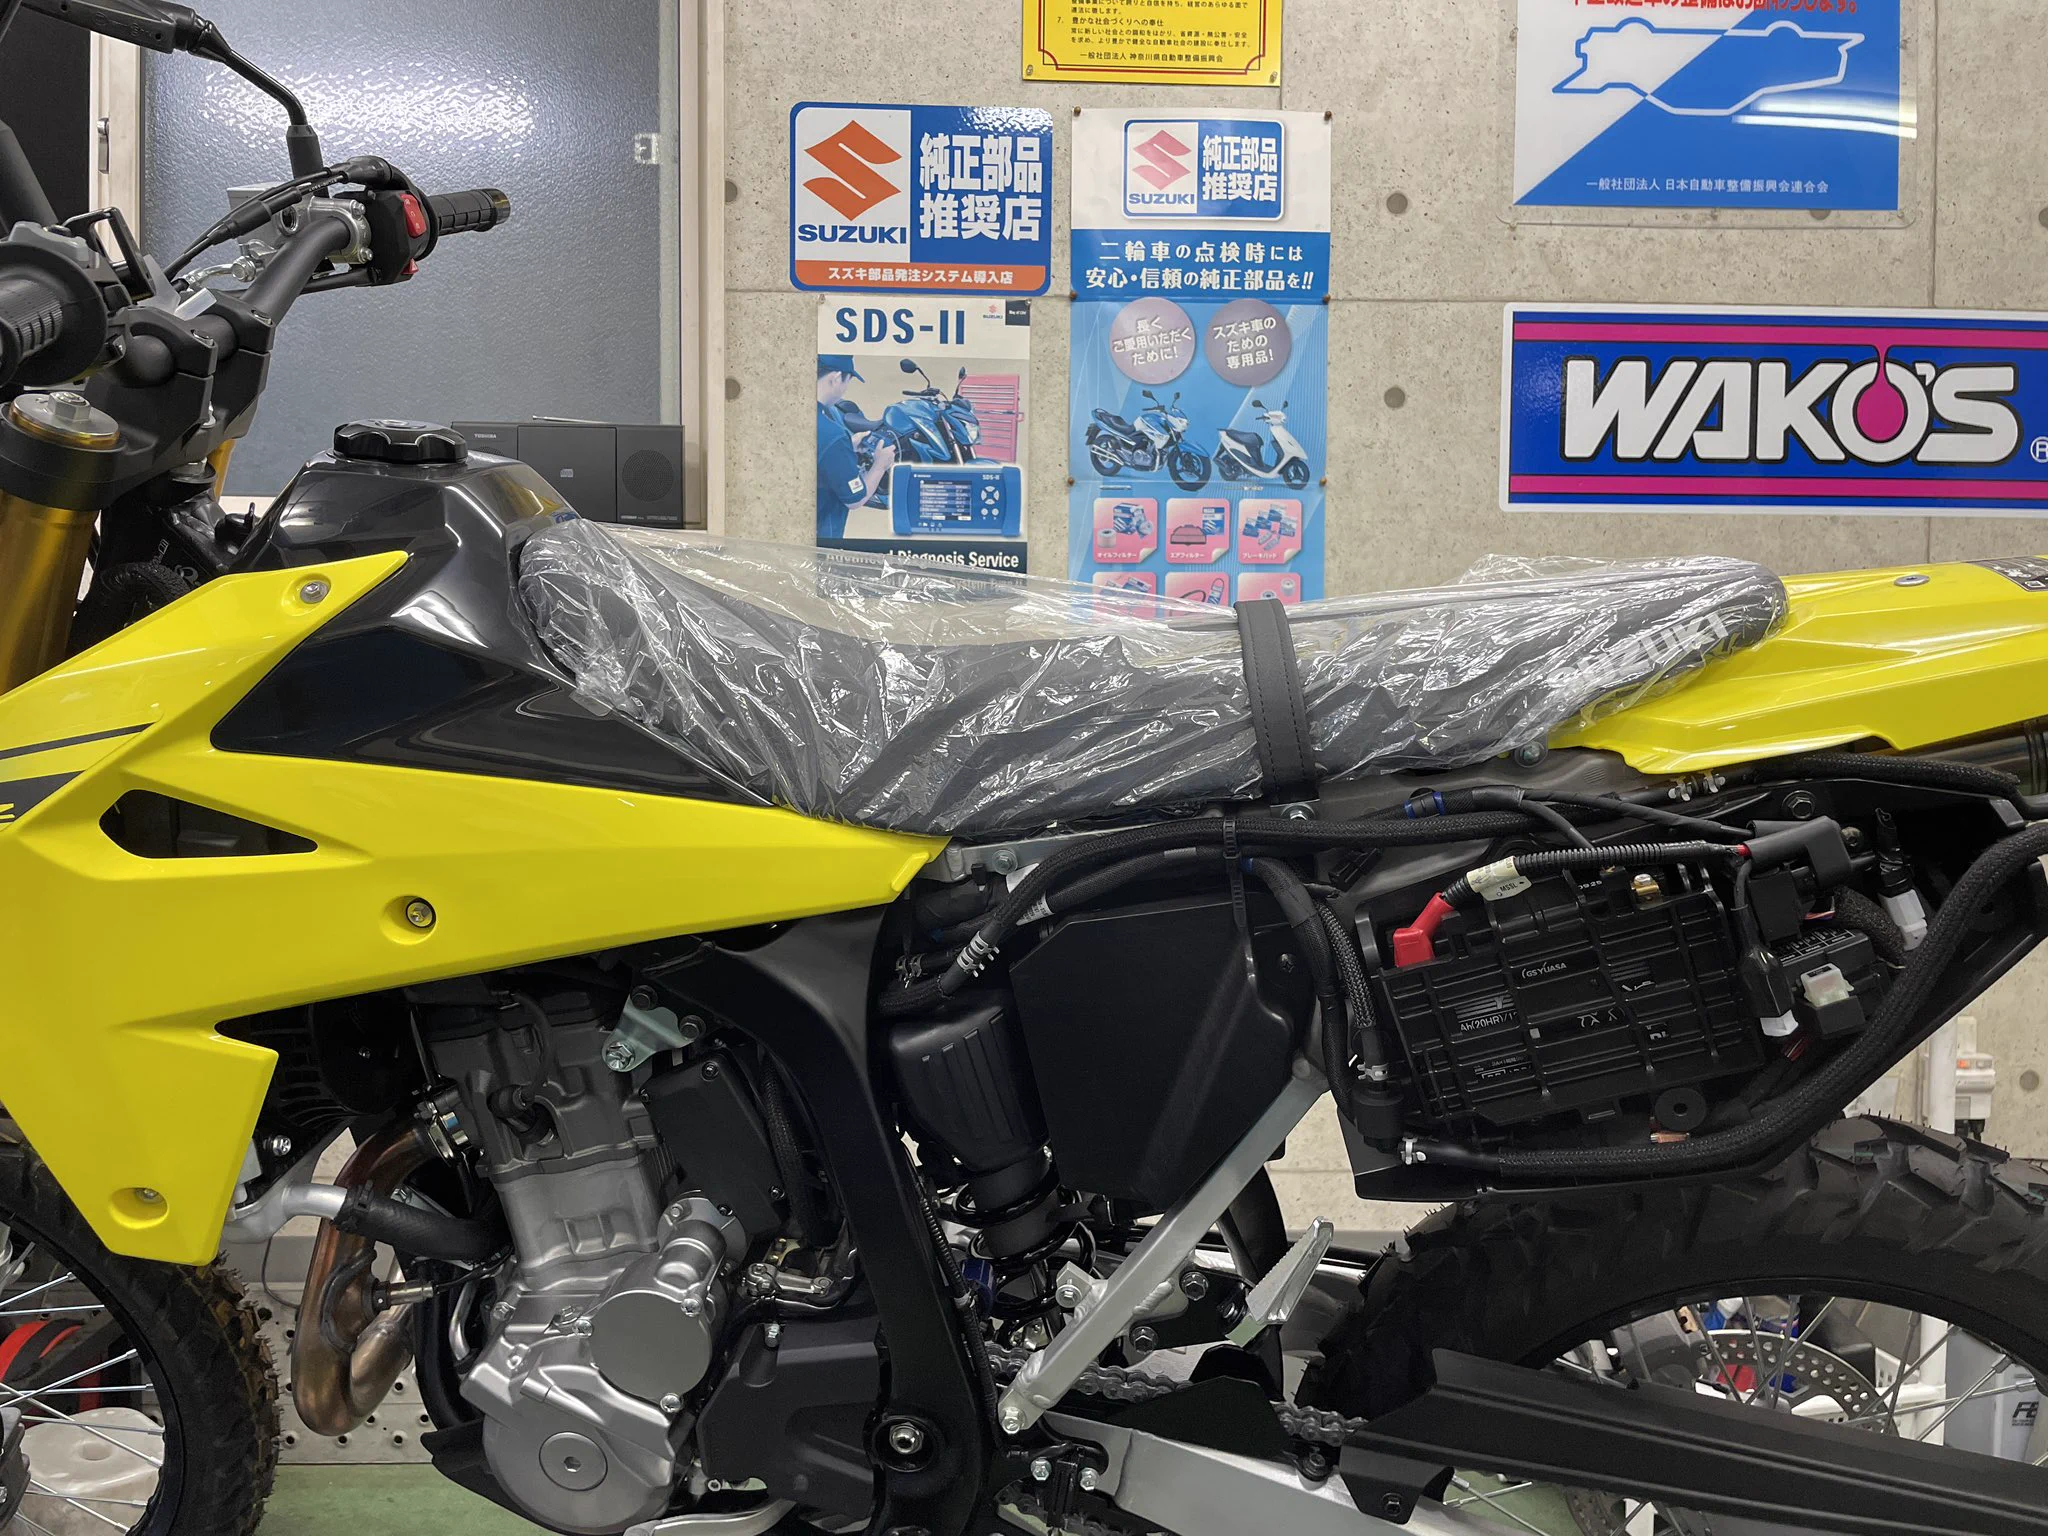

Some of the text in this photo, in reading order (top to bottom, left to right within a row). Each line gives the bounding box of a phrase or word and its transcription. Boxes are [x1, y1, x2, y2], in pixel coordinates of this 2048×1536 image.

[919, 132, 1043, 193] 純正部品
[1202, 135, 1278, 173] 純正部品
[1202, 172, 1278, 202] 推奨店
[1586, 177, 1829, 194] 一般社団法人 日本自動車整備振興会連合会
[1128, 193, 1195, 205] SUZUKI
[919, 192, 1042, 241] 推奨店
[798, 223, 907, 245] SUZUKI
[1099, 240, 1304, 264] 二輪車の点検時には
[828, 266, 1014, 285] スズキ部品発注システム導入店
[1136, 316, 1163, 334] 長く
[1213, 316, 1277, 339] スズキ車の
[1112, 327, 1192, 353] ご愛用いただく
[1226, 334, 1268, 354] ための
[1563, 358, 2020, 464] WAKO'S
[969, 551, 1020, 568] Service
